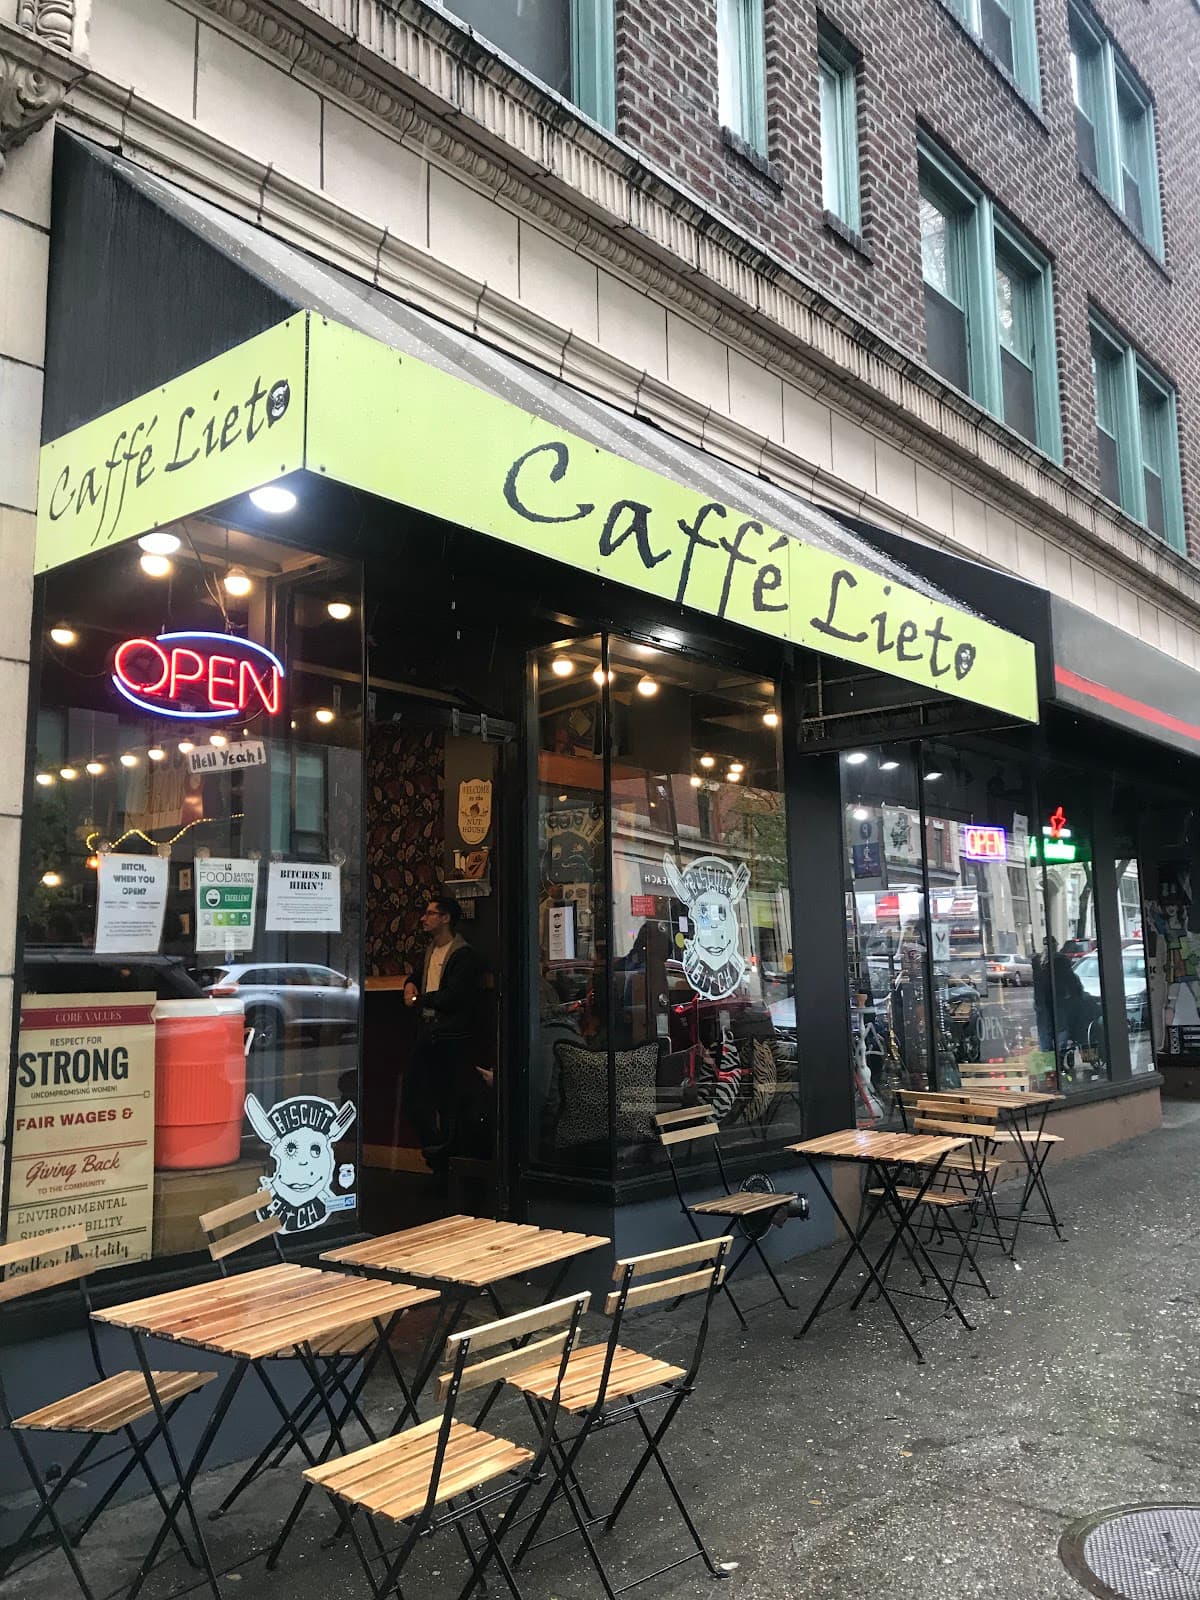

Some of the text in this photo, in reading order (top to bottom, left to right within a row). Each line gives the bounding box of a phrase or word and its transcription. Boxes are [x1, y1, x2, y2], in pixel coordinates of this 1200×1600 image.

[49, 375, 291, 546] Caffé Lieto
[502, 441, 976, 681] Caffé Lieto
[114, 638, 280, 714] OPEN
[465, 818, 483, 826] NUT
[462, 826, 486, 834] HOUSE
[968, 829, 1004, 857] OPEN
[113, 874, 156, 884] WHEN YOU
[200, 871, 233, 883] FOOD
[280, 870, 333, 880] BITCHES BE
[122, 887, 147, 896] OPEN?
[55, 1010, 122, 1024] CORE VALUES
[50, 1036, 102, 1047] RESPECT FOR
[18, 1046, 129, 1088] STRONG
[30, 1085, 118, 1100] UNCOMPROMISING WOMEN!
[16, 1107, 134, 1131] FAIR WAGES &
[25, 1151, 121, 1188] Giving Back
[37, 1187, 48, 1195] TO
[63, 1179, 107, 1191] COMMUNITY
[17, 1196, 128, 1225] ENVIRONMENTAL
